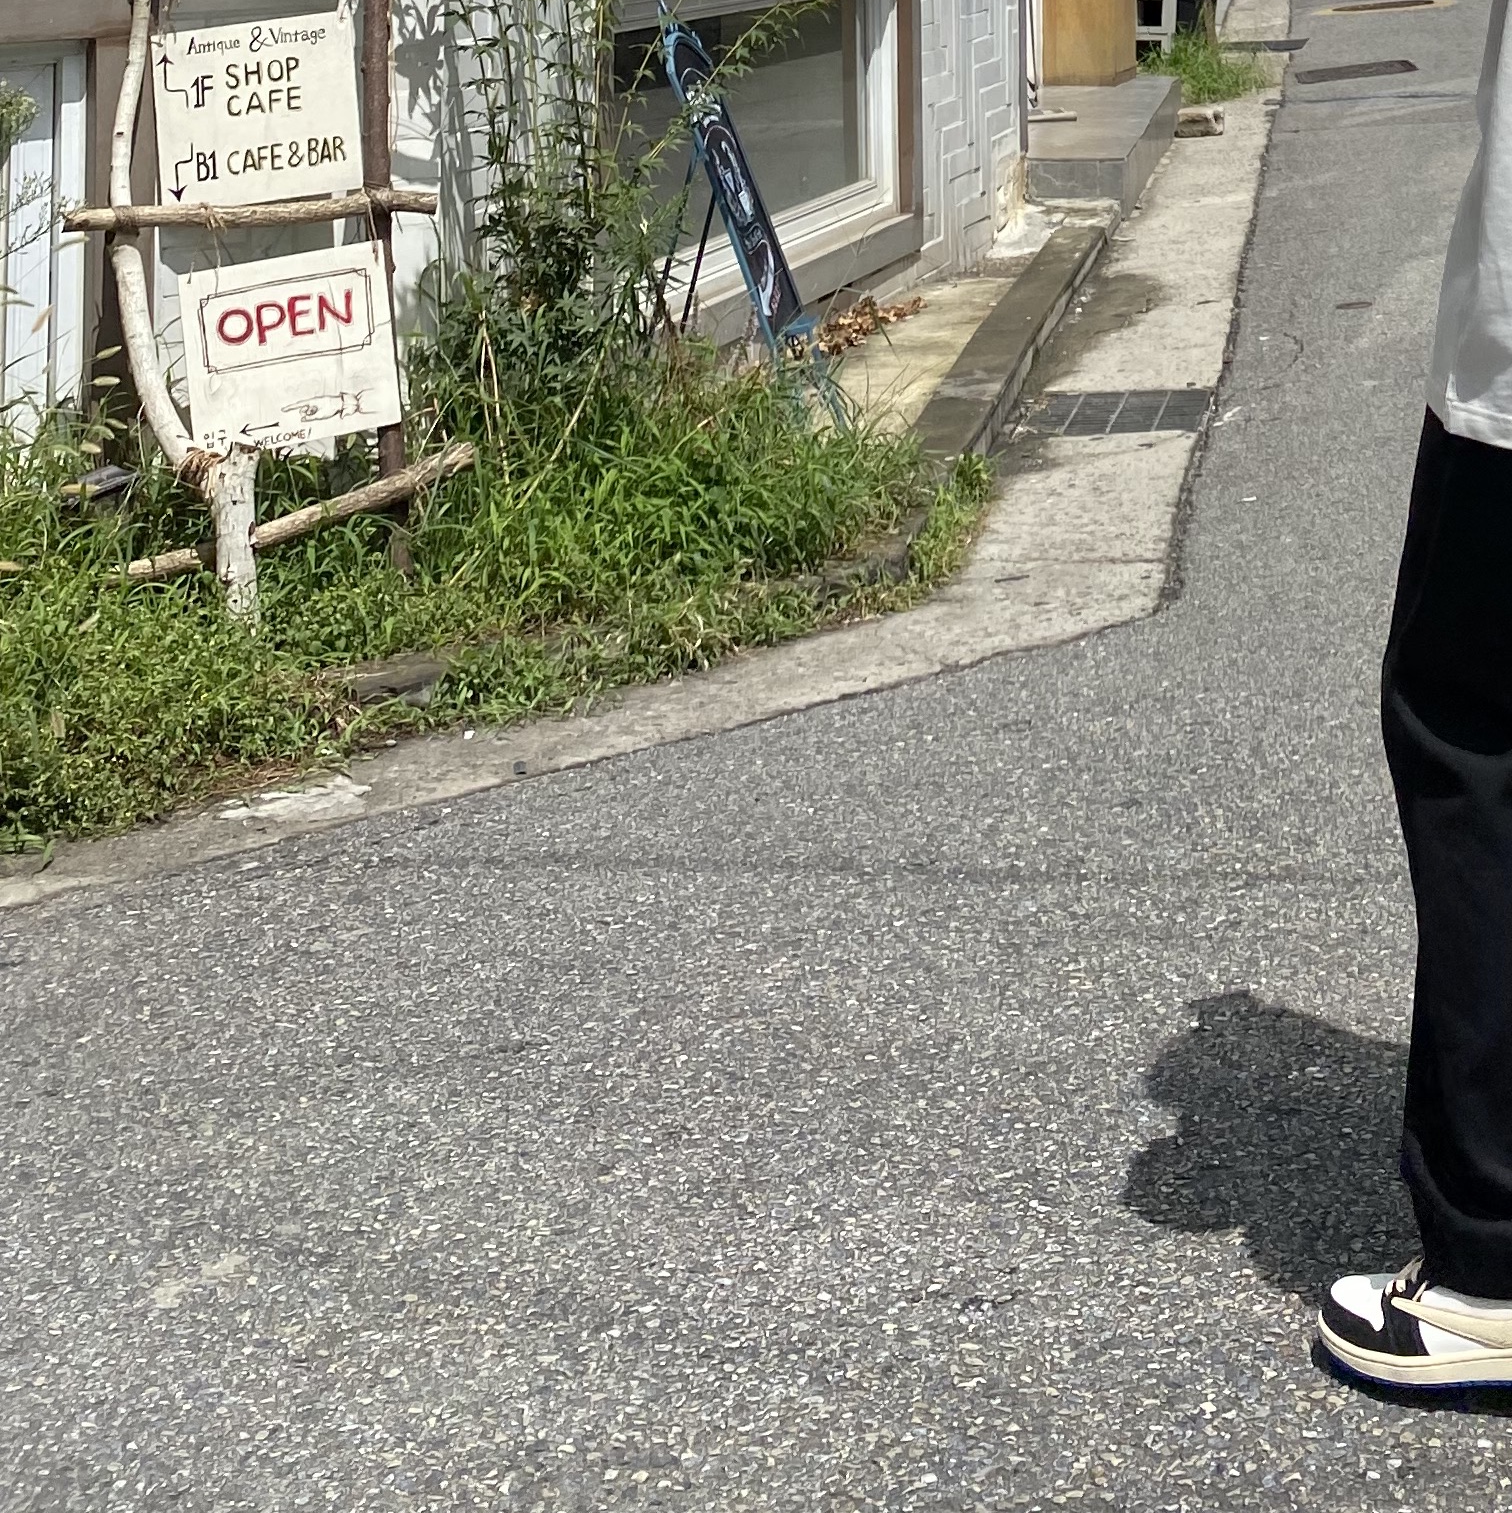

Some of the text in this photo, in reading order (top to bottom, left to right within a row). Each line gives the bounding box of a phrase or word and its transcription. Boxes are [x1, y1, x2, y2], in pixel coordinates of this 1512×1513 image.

[186, 36, 241, 56] Antique
[225, 56, 300, 89] SHOP
[190, 74, 214, 109] 1F
[226, 85, 303, 117] CAFE
[196, 149, 220, 182] B1
[217, 289, 353, 346] OPEN
